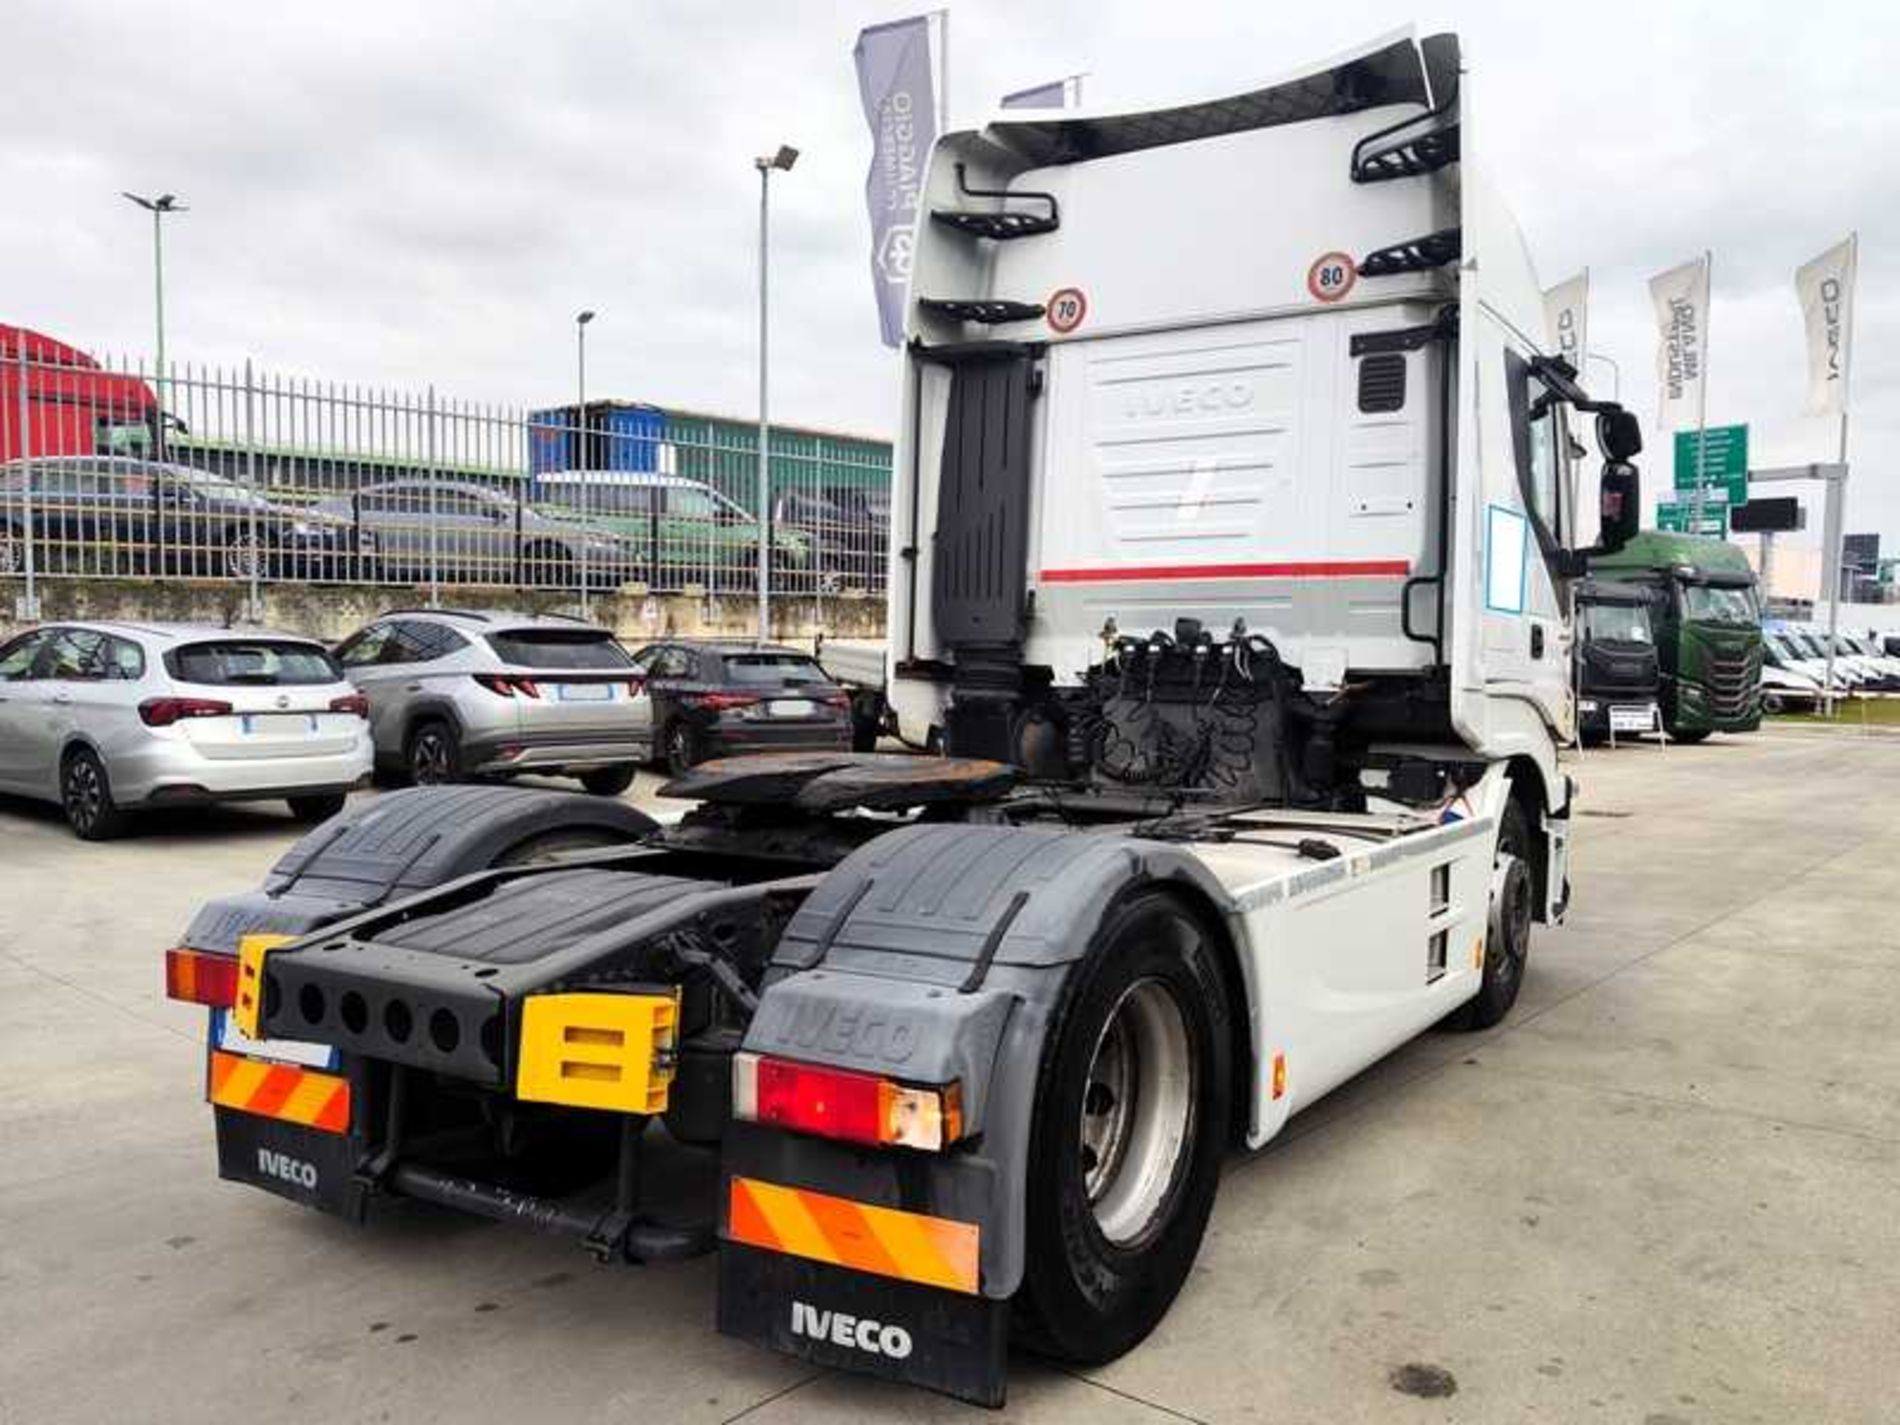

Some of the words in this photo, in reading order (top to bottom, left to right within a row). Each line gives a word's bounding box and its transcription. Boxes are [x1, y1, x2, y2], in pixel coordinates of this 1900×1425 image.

[1320, 265, 1343, 286] 80
[1059, 300, 1077, 319] 70
[1122, 384, 1254, 417] IVECO
[772, 1003, 914, 1065] IVECO
[258, 1147, 318, 1189] IVECO
[791, 1300, 913, 1359] IVECO
